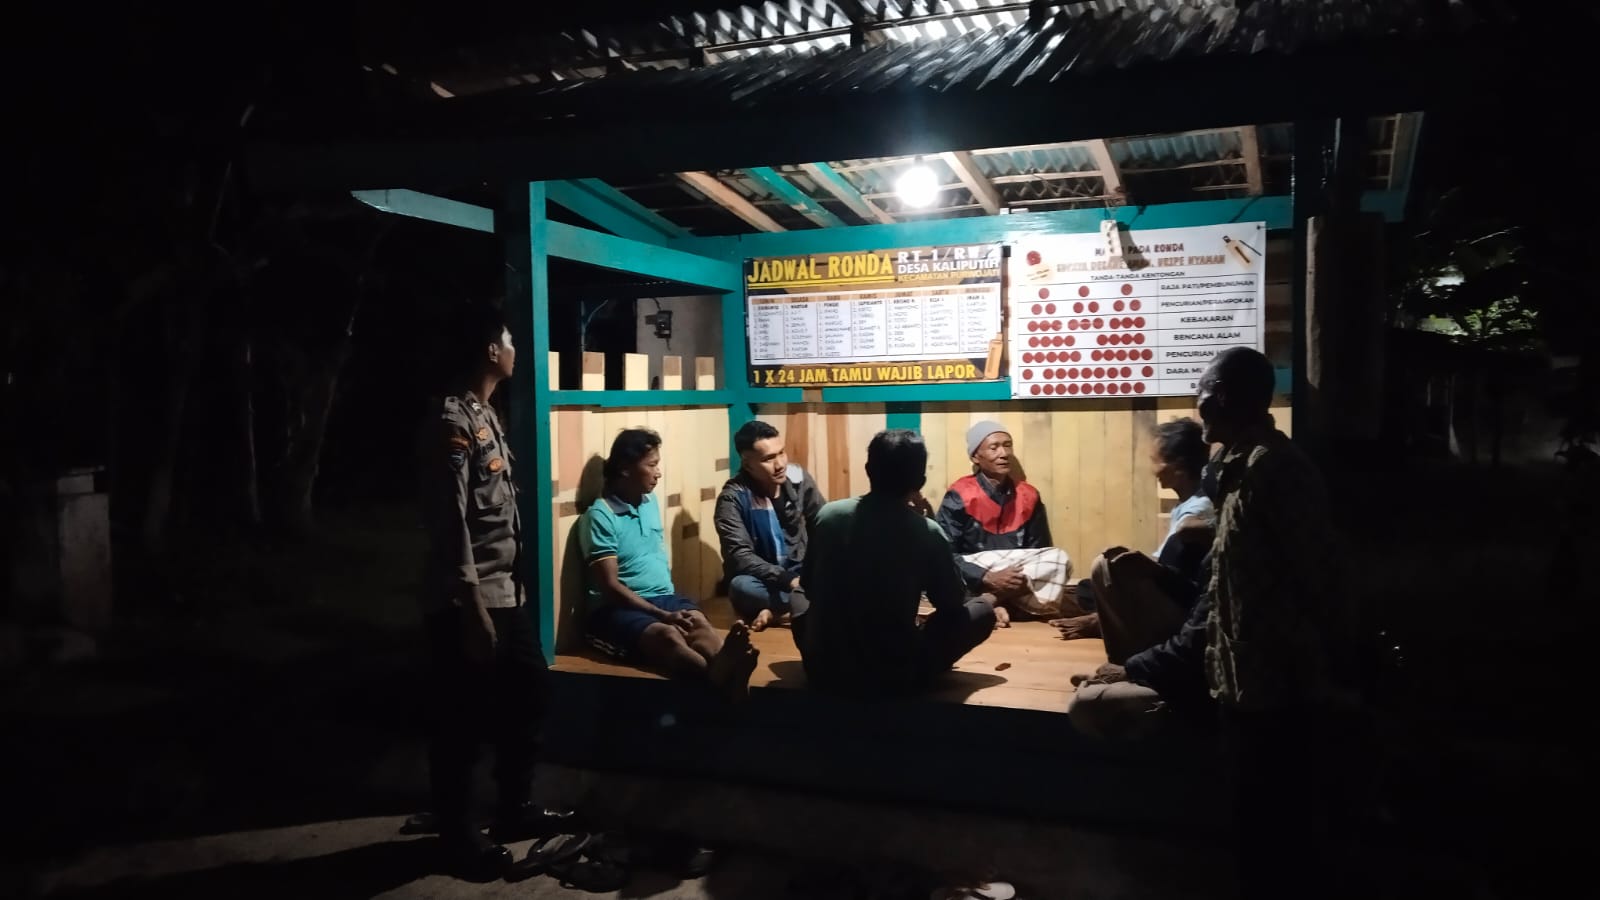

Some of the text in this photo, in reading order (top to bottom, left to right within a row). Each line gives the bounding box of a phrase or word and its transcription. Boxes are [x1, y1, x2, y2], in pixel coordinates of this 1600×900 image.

[1154, 243, 1185, 253] RONDA
[747, 253, 893, 283] JADWAL RONDA
[897, 259, 1000, 275] DESA KALIPUTIH
[1141, 270, 1186, 278] KENTONGAN
[1180, 315, 1234, 323] KEBAKARAN
[1173, 331, 1241, 341] BENCANA ALAM
[1165, 350, 1215, 358] PENCURIAN
[753, 364, 976, 384] 1 X 24 JAM TAMU WAJIB LAPOR
[1166, 367, 1190, 375] DARA
